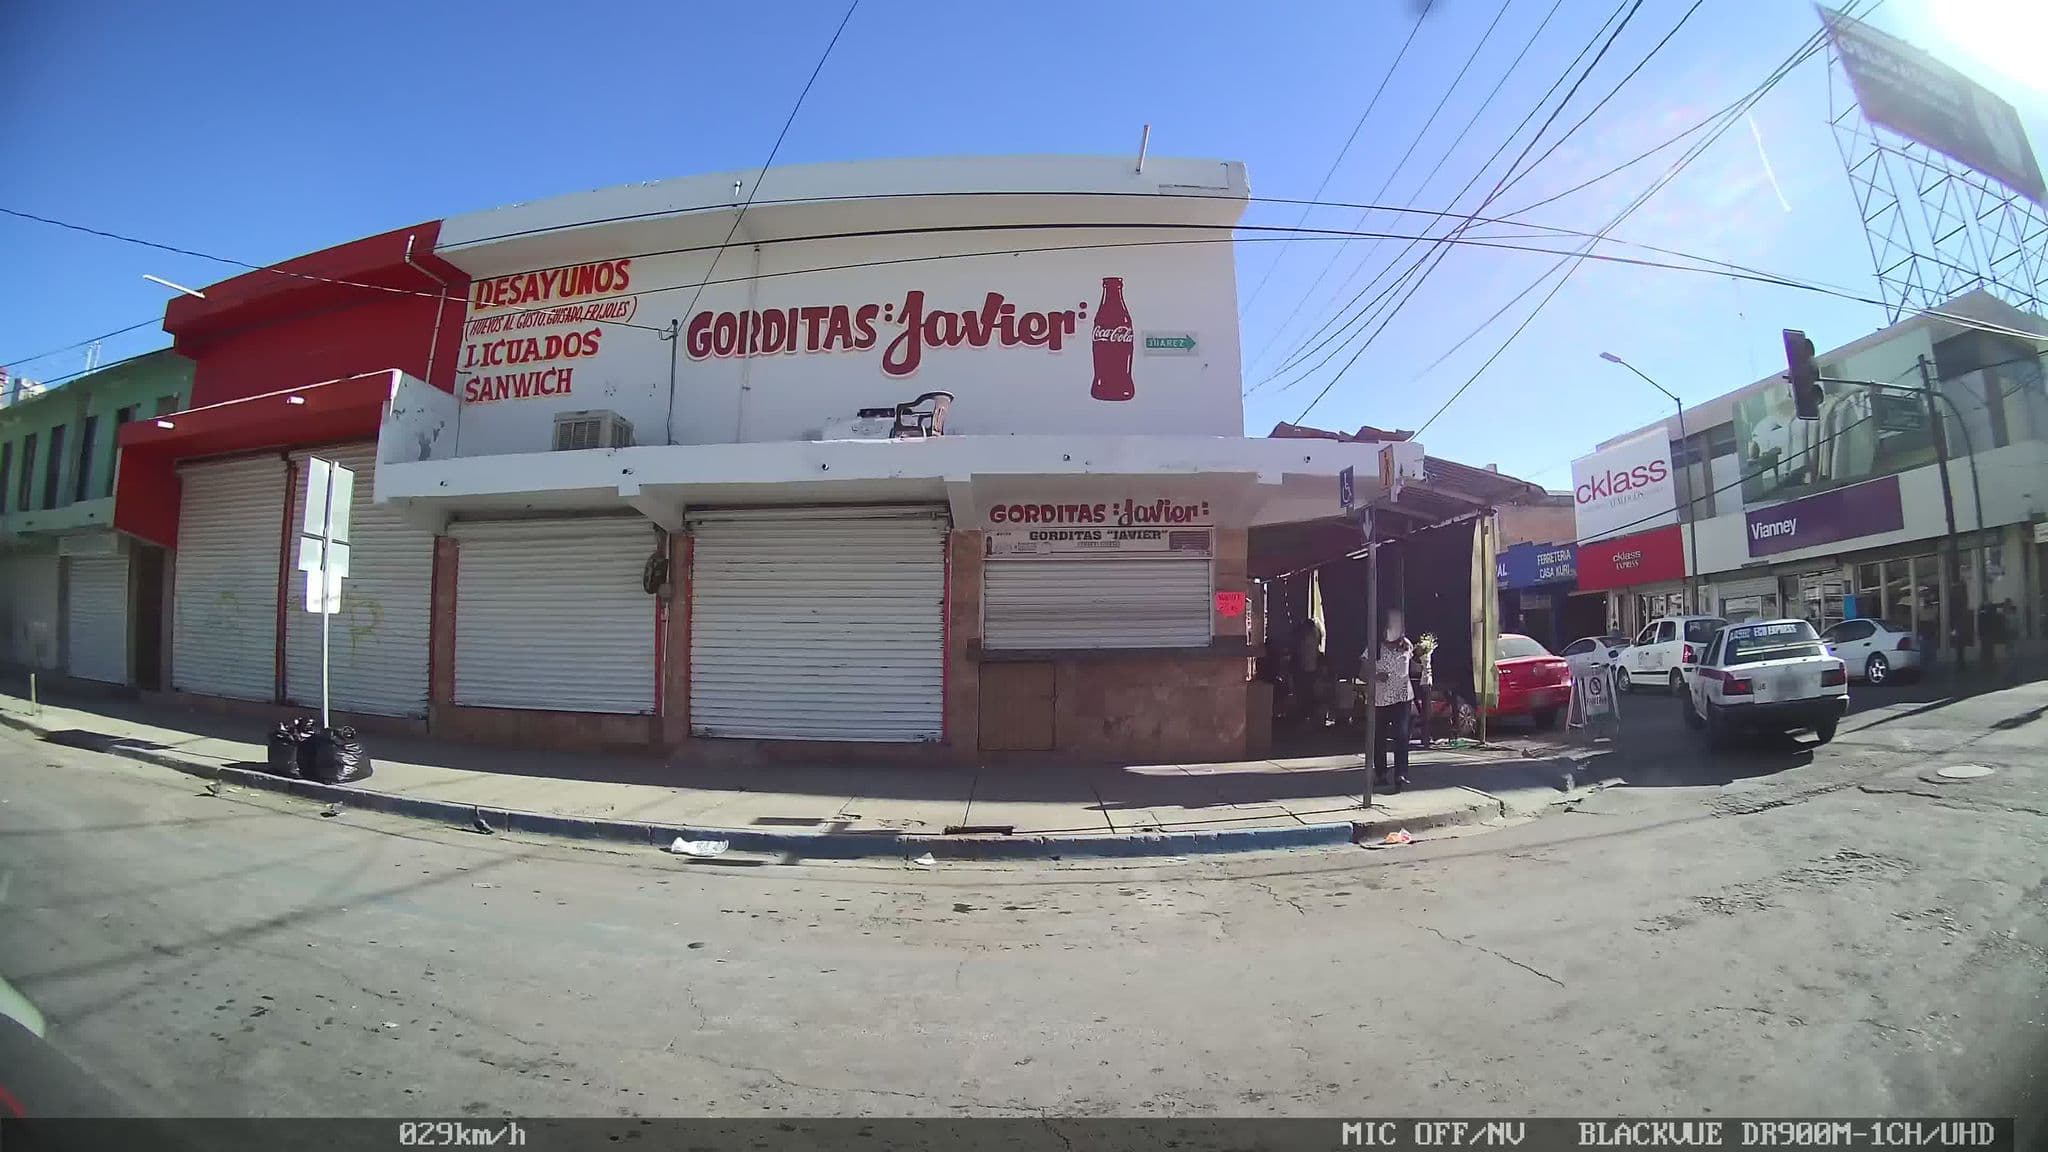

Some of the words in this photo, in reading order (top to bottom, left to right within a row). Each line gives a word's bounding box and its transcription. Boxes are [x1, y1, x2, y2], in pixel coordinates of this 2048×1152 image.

[474, 260, 631, 310] DESAYUNOS
[687, 304, 879, 358] GORDITAS
[464, 327, 602, 368] LICUADOS
[465, 367, 574, 403] SANWICH
[1576, 460, 1667, 504] cklass
[989, 503, 1106, 524] GORDITAS
[1029, 530, 1102, 541] GORDITAS
[1107, 530, 1168, 540] "JAVIER"
[1751, 518, 1797, 540] Vianney
[1536, 549, 1572, 566] FERRETERIA
[1612, 551, 1641, 562] cklass
[1539, 567, 1555, 579] CASA
